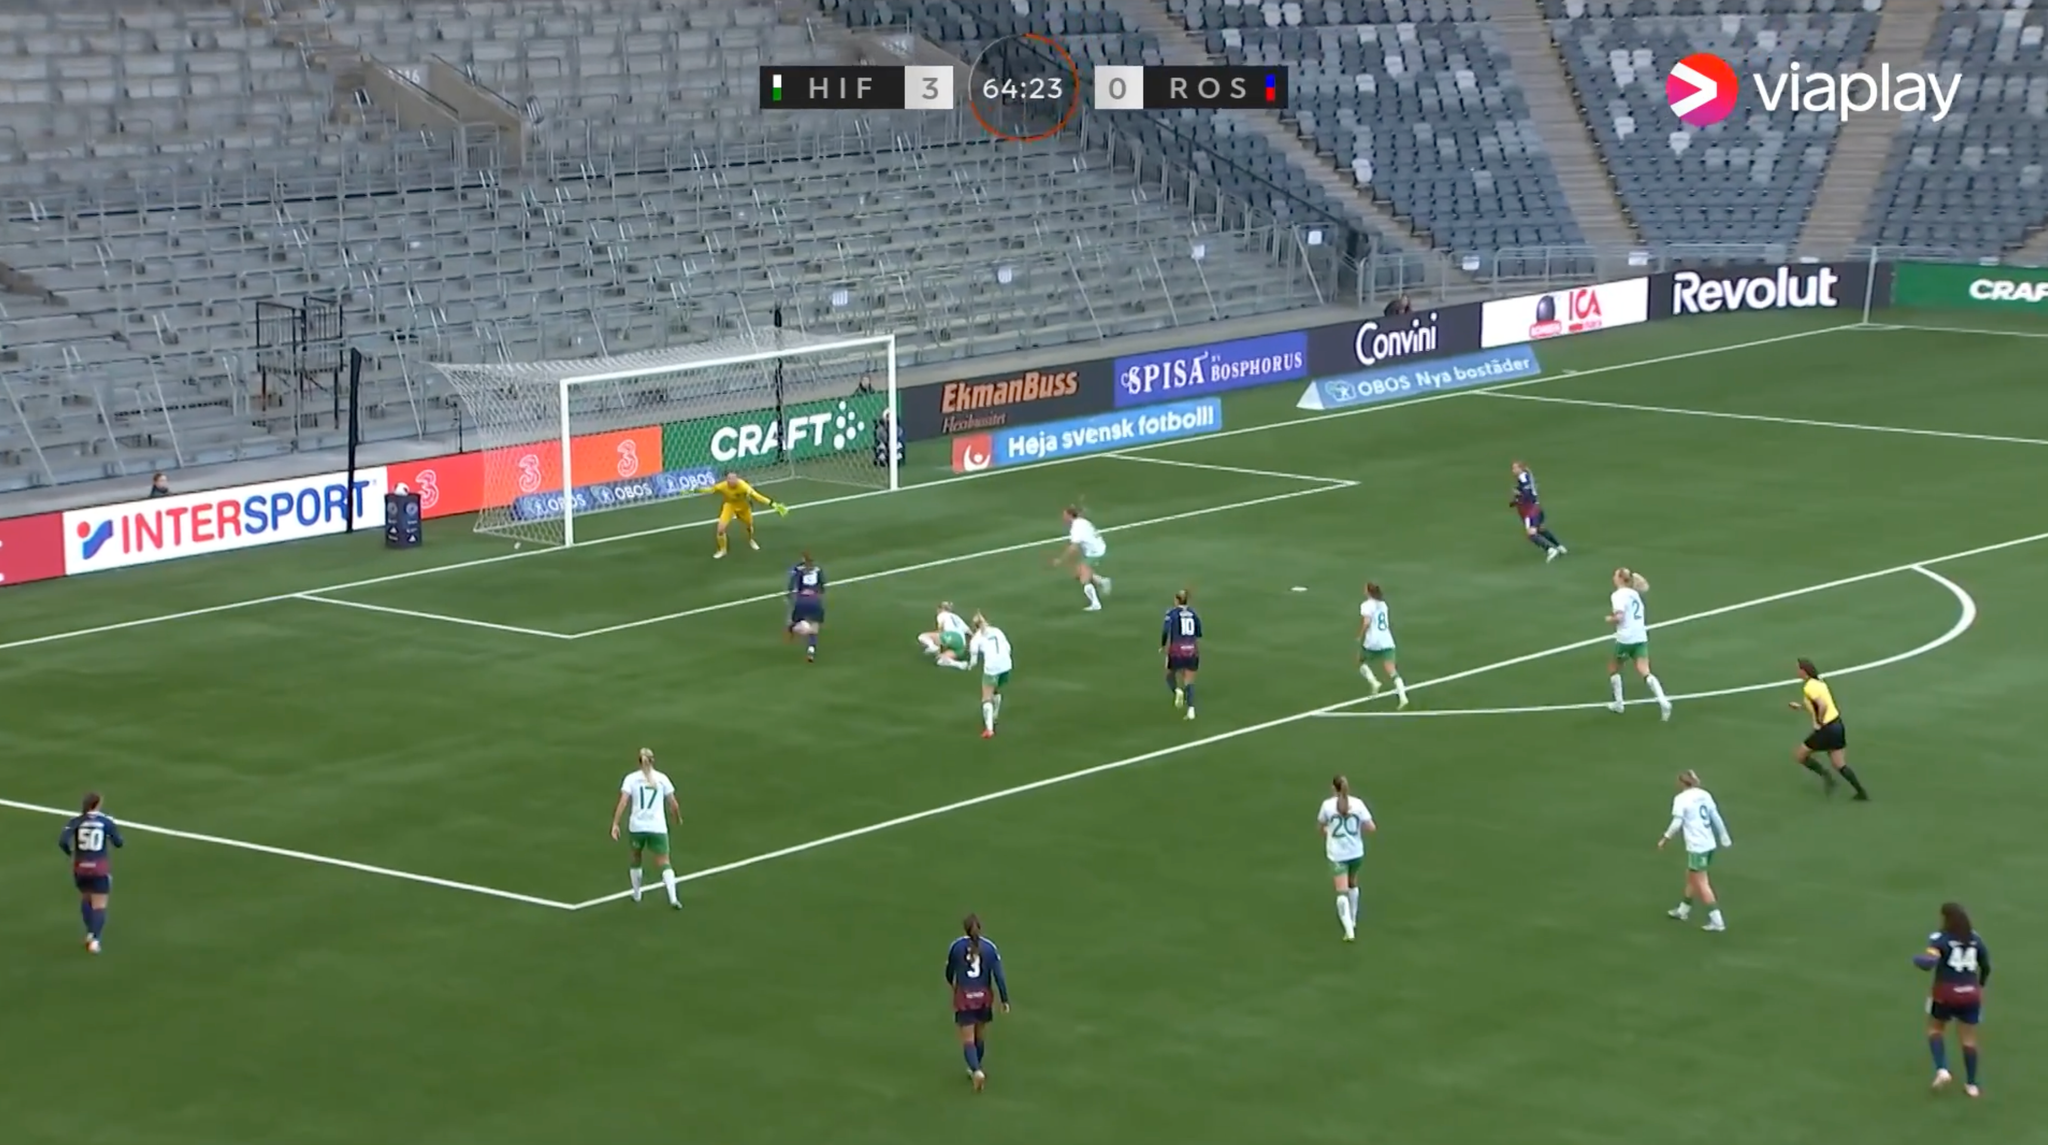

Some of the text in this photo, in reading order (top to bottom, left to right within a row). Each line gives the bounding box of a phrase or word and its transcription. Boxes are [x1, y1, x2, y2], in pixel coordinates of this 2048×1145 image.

[1568, 288, 1602, 321] ICA
[1673, 266, 1839, 316] Revolut
[1355, 312, 1438, 366] Convini
[1210, 351, 1303, 382] BOSPHORUS
[1357, 357, 1530, 397] OBOS Nya bostäder
[941, 371, 1080, 414] EkmanBuss
[711, 412, 832, 462] CRAFT
[1008, 431, 1058, 458] Heja
[1062, 418, 1135, 450] svensk
[518, 453, 542, 493] 3
[617, 439, 639, 478] 3
[415, 469, 440, 509] 3
[614, 483, 653, 501] OBOS
[679, 471, 716, 491] OBOS
[122, 479, 370, 554] INTERSPORT
[1377, 611, 1388, 631] 8
[1631, 599, 1642, 620] 2
[1180, 617, 1196, 636] 10
[987, 635, 1000, 655] 7
[639, 784, 658, 810] 17
[1330, 813, 1360, 838] 20
[1699, 804, 1711, 829] 9
[77, 828, 104, 852] 50
[966, 953, 982, 978] 3
[1947, 946, 1979, 973] 44
